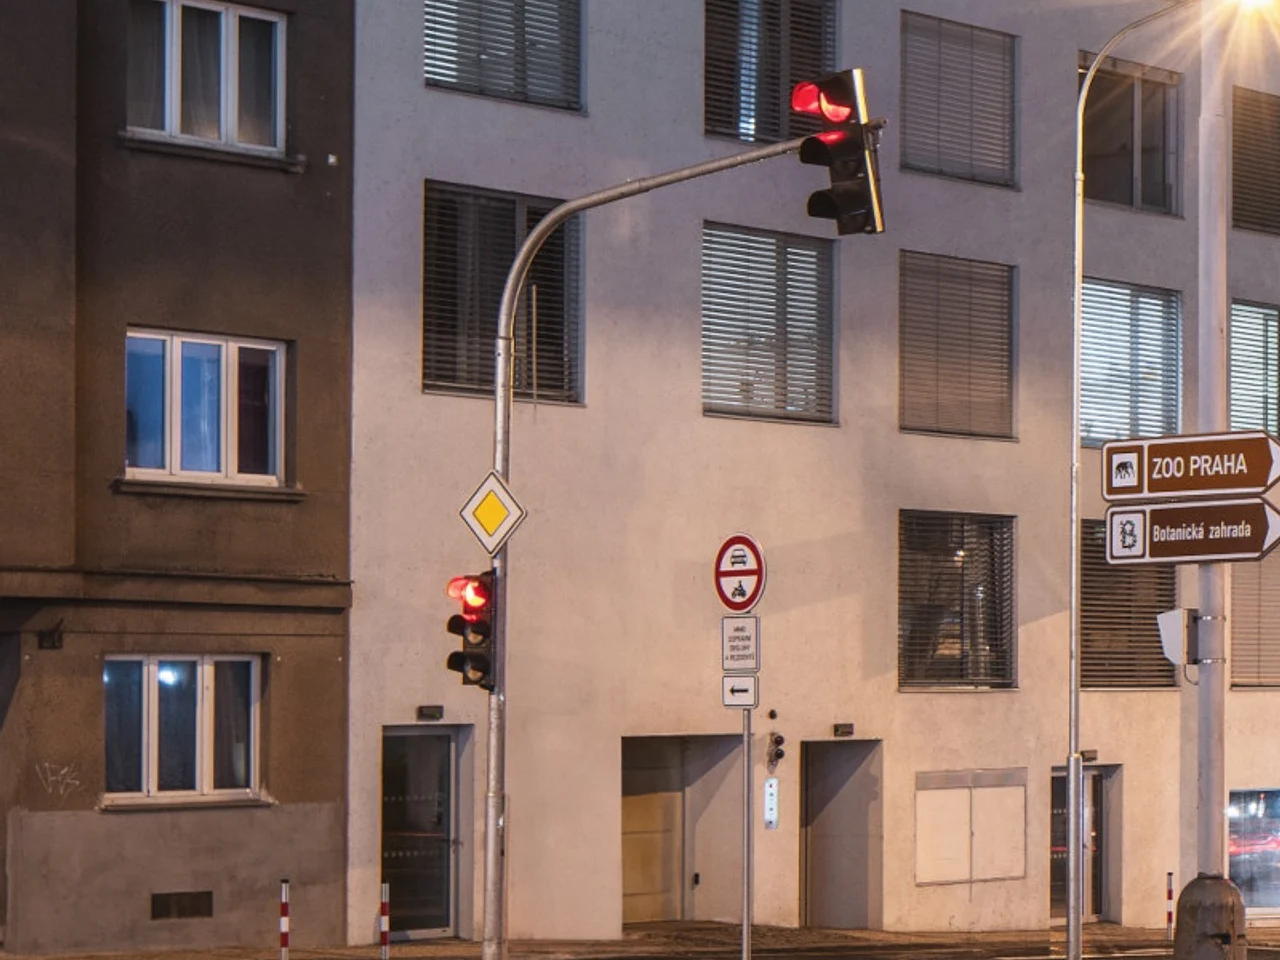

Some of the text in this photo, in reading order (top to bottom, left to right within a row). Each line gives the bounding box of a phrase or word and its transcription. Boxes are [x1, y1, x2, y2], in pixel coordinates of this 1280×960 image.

[1151, 452, 1248, 479] ZOO PRAHA
[1152, 520, 1251, 542] Botanická zahrada
